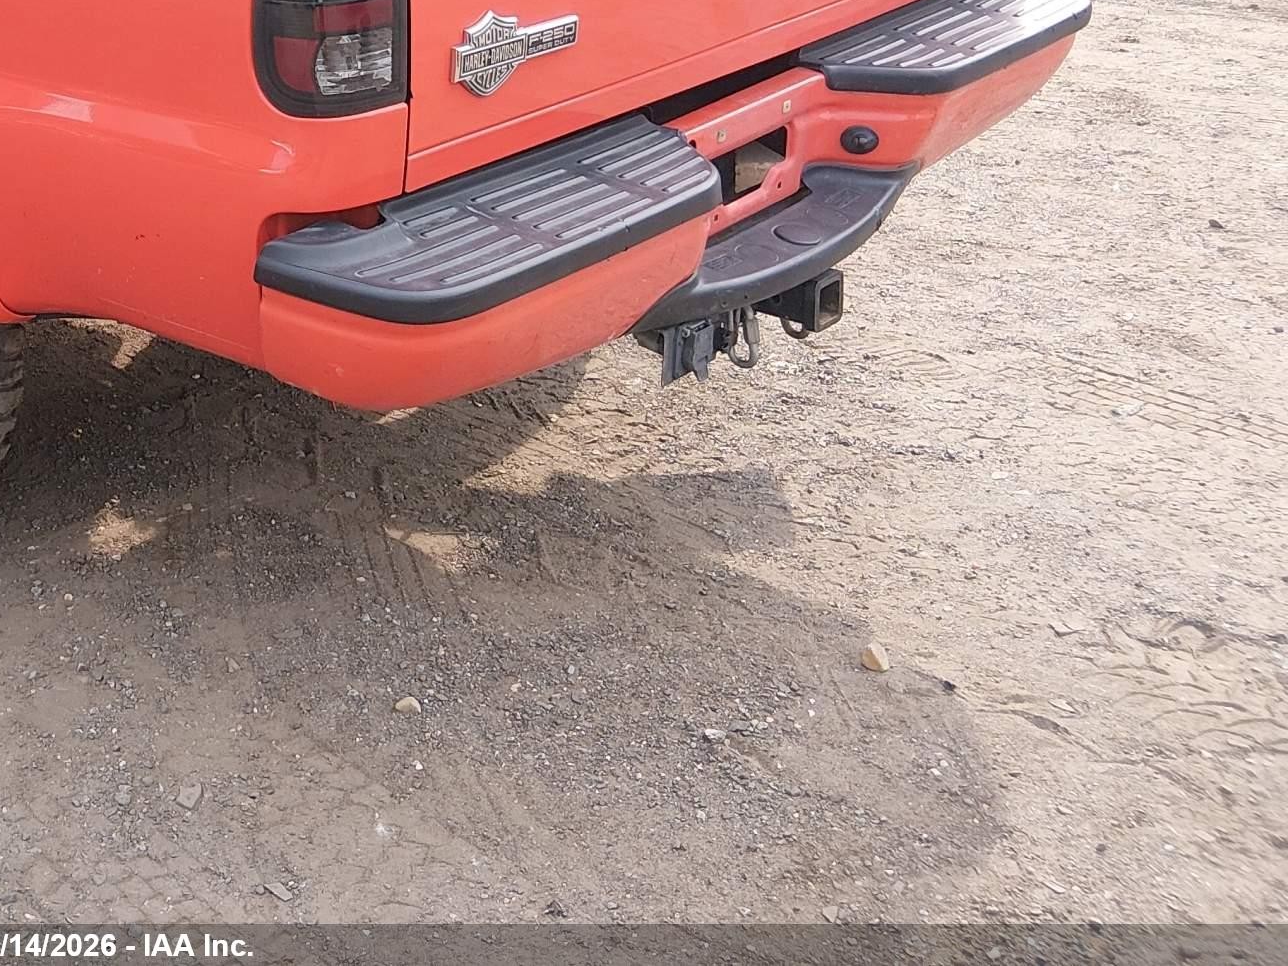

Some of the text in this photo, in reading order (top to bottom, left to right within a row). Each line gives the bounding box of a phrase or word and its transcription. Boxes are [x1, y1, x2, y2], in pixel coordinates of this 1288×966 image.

[477, 24, 511, 47] MOTOR
[528, 23, 576, 47] F-250
[528, 35, 575, 55] SUPER DUTY
[463, 39, 524, 73] HARLEY-DAVIDSON
[475, 64, 508, 89] CYCLES
